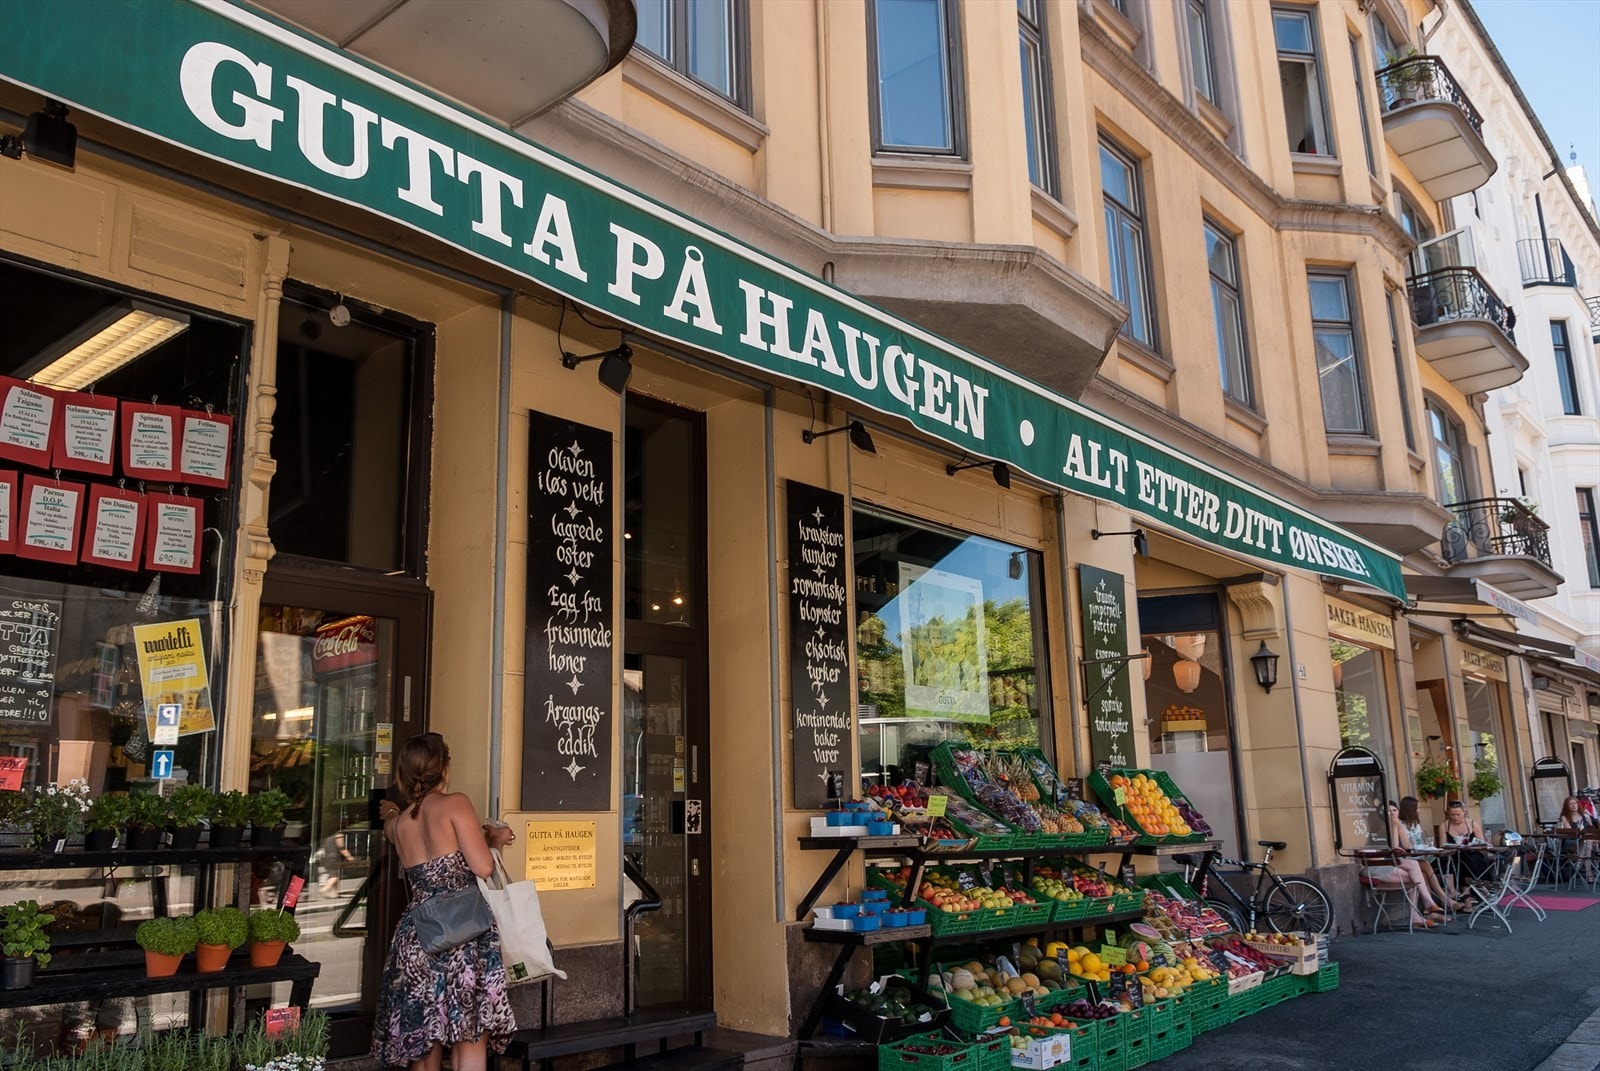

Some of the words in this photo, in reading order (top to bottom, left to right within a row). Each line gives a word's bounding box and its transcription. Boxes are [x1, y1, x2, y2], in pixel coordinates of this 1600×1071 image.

[180, 42, 588, 283] GUTTA
[608, 222, 723, 335] PÅ
[738, 278, 990, 440] HAUGEN
[1063, 434, 1128, 495] ALT
[1136, 459, 1220, 534] ETTER
[1223, 500, 1284, 554] DITT
[1289, 524, 1370, 578] ØNSKE!
[20, 390, 42, 400] Salame
[67, 406, 90, 414] Salame
[92, 409, 113, 417] Napoli
[140, 414, 163, 422] Spinata
[138, 422, 164, 430] Piccante
[30, 440, 40, 448] Kg
[548, 447, 596, 478] Oliven
[44, 488, 64, 496] Parma
[538, 472, 544, 492] i
[546, 470, 568, 496] løs
[572, 480, 604, 505] vekt
[44, 504, 60, 512] Italia
[114, 501, 134, 510] Daniele
[552, 514, 604, 544] lagrede
[799, 520, 844, 548] kravstore
[556, 545, 594, 568] oster
[802, 544, 838, 568] kunder
[792, 576, 846, 606] romantiske
[548, 584, 580, 624] Egg
[580, 590, 602, 624] fra
[800, 600, 842, 625] blomster
[544, 616, 612, 651] frisinnede
[1328, 604, 1358, 628] BAKER
[1358, 615, 1392, 639] HANSEN
[143, 627, 192, 653] martelli
[805, 636, 848, 667] eksotisk
[549, 645, 586, 674] høner
[544, 694, 604, 734] Årgangs-
[796, 708, 851, 730] kontinentale
[558, 728, 598, 758] eddik
[814, 728, 840, 746] baker-
[813, 748, 840, 763] varer
[1109, 752, 1126, 768] pasta
[554, 828, 563, 838] PÅ
